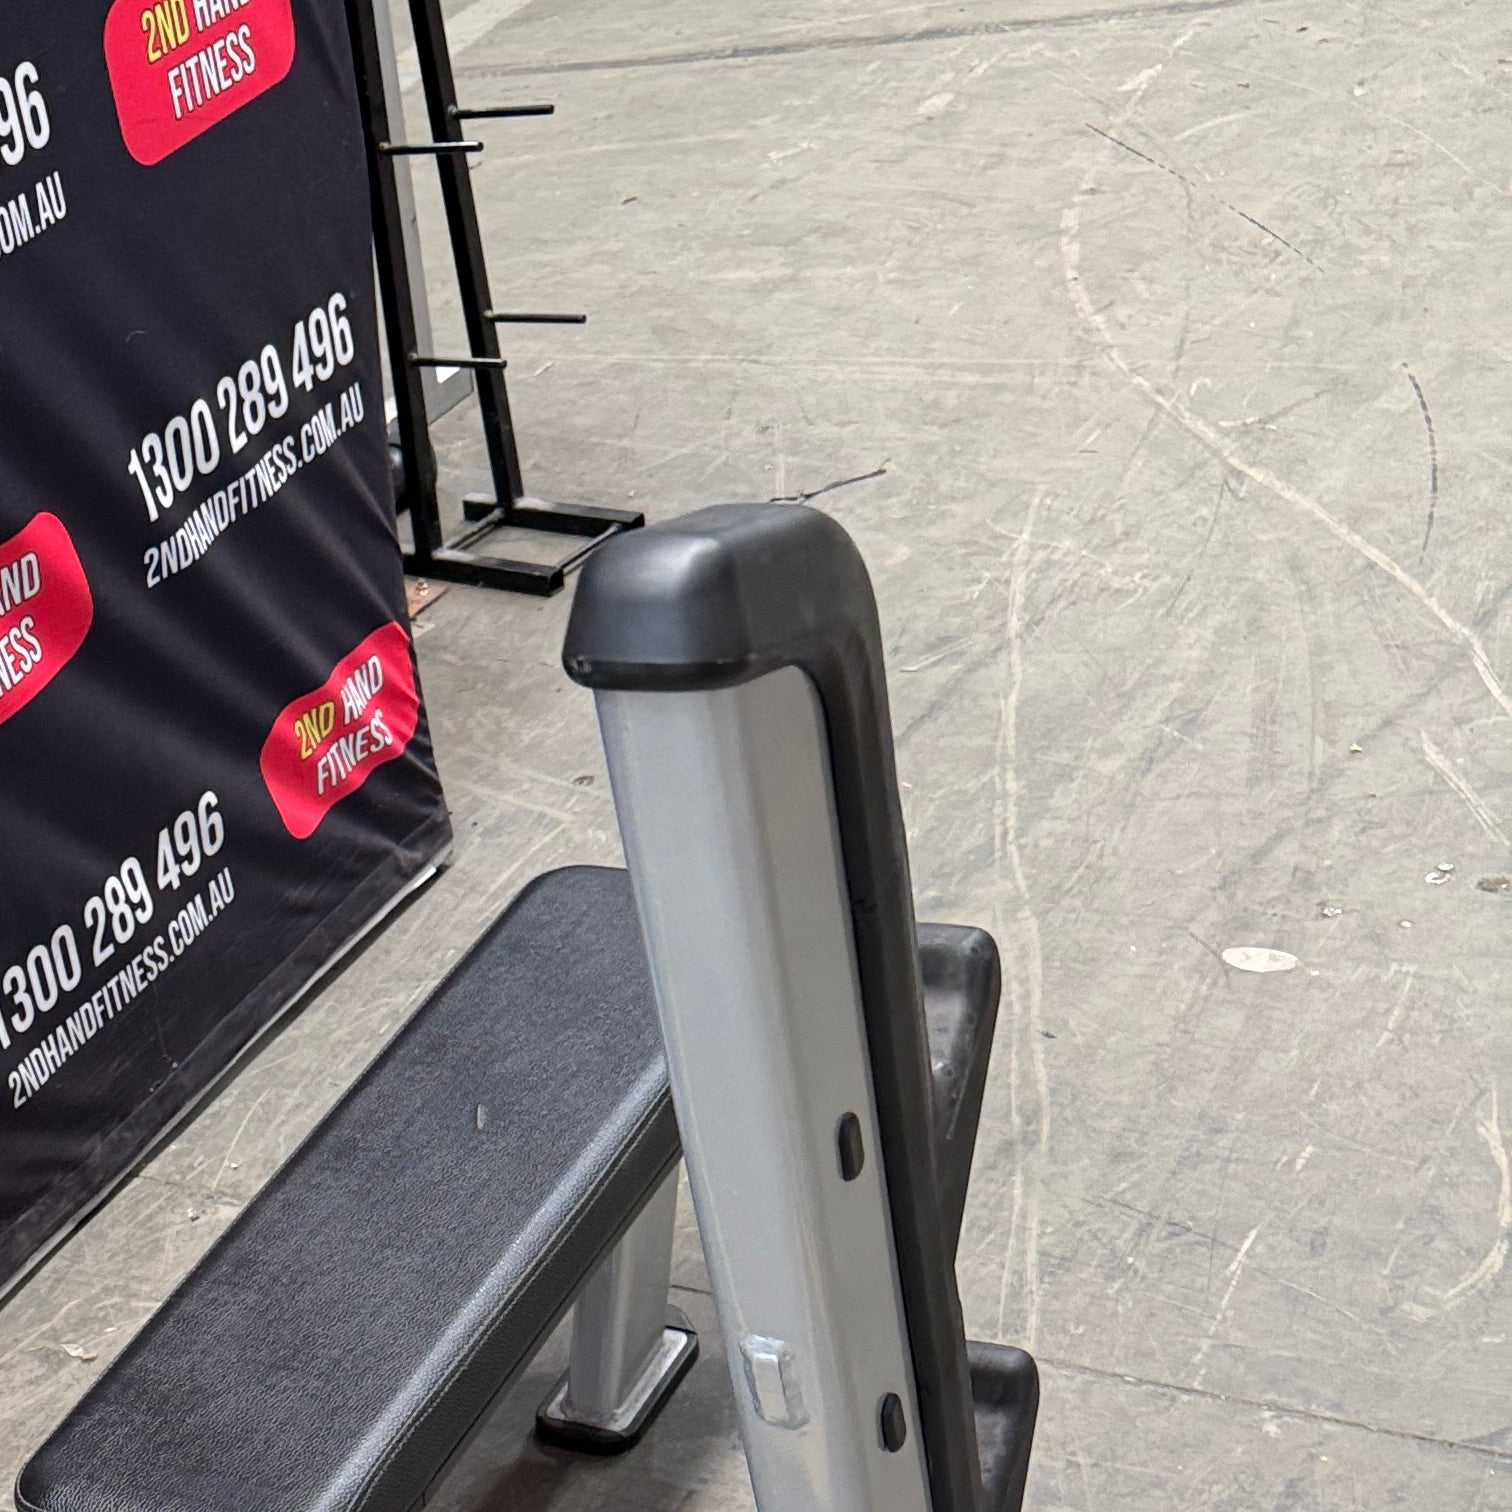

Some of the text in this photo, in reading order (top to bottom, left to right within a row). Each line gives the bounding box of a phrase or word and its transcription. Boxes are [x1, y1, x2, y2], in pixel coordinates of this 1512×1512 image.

[141, 0, 190, 63] 2ND
[168, 24, 256, 119] FITNESS
[128, 292, 354, 522] 1300 289 496
[143, 382, 364, 589] 2NDHANDFITNESS.COM.AU
[294, 655, 383, 760] 2ND HAND
[317, 709, 393, 795] FITNESS
[84, 856, 154, 967] 289
[156, 791, 225, 891] 496
[7, 867, 236, 1109] 2NDHANDFITNESS.COM.AU
